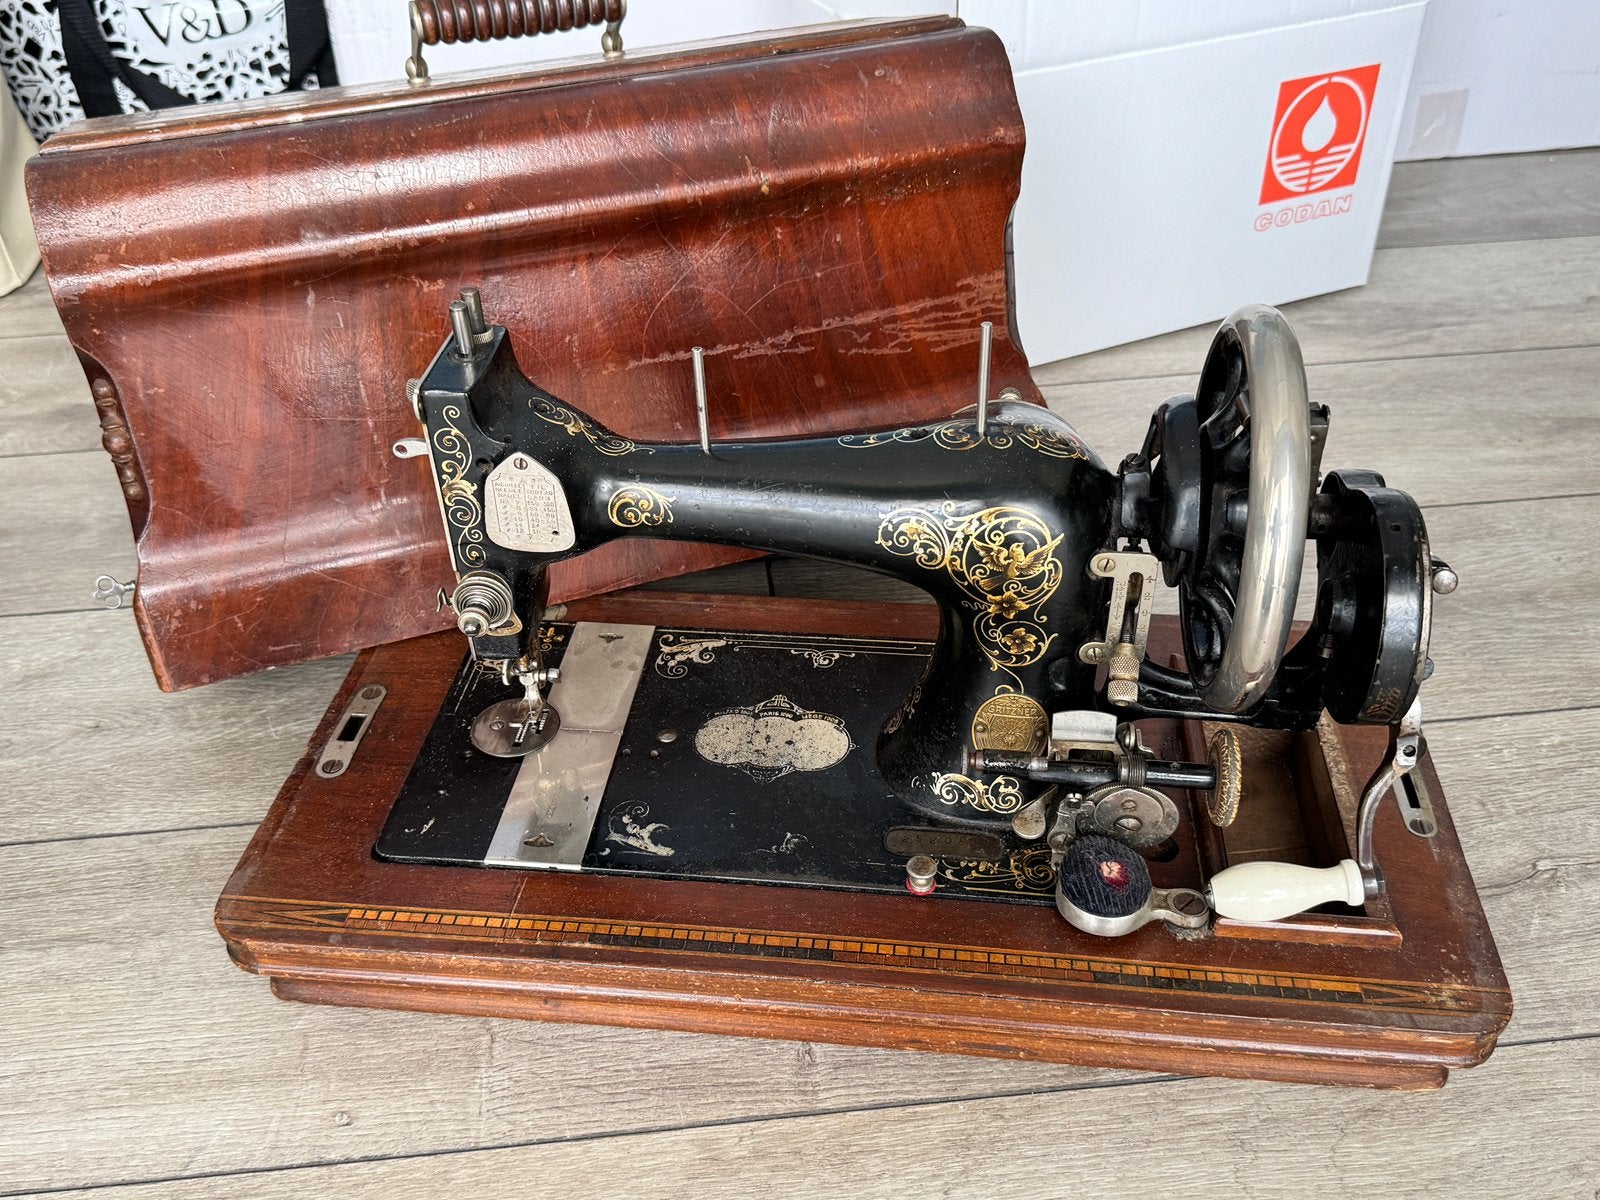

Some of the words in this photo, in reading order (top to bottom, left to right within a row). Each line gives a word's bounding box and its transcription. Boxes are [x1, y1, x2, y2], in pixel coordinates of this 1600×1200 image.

[133, 0, 252, 47] V&D
[1254, 195, 1352, 231] CODAN
[988, 704, 1038, 717] GRITZNER
